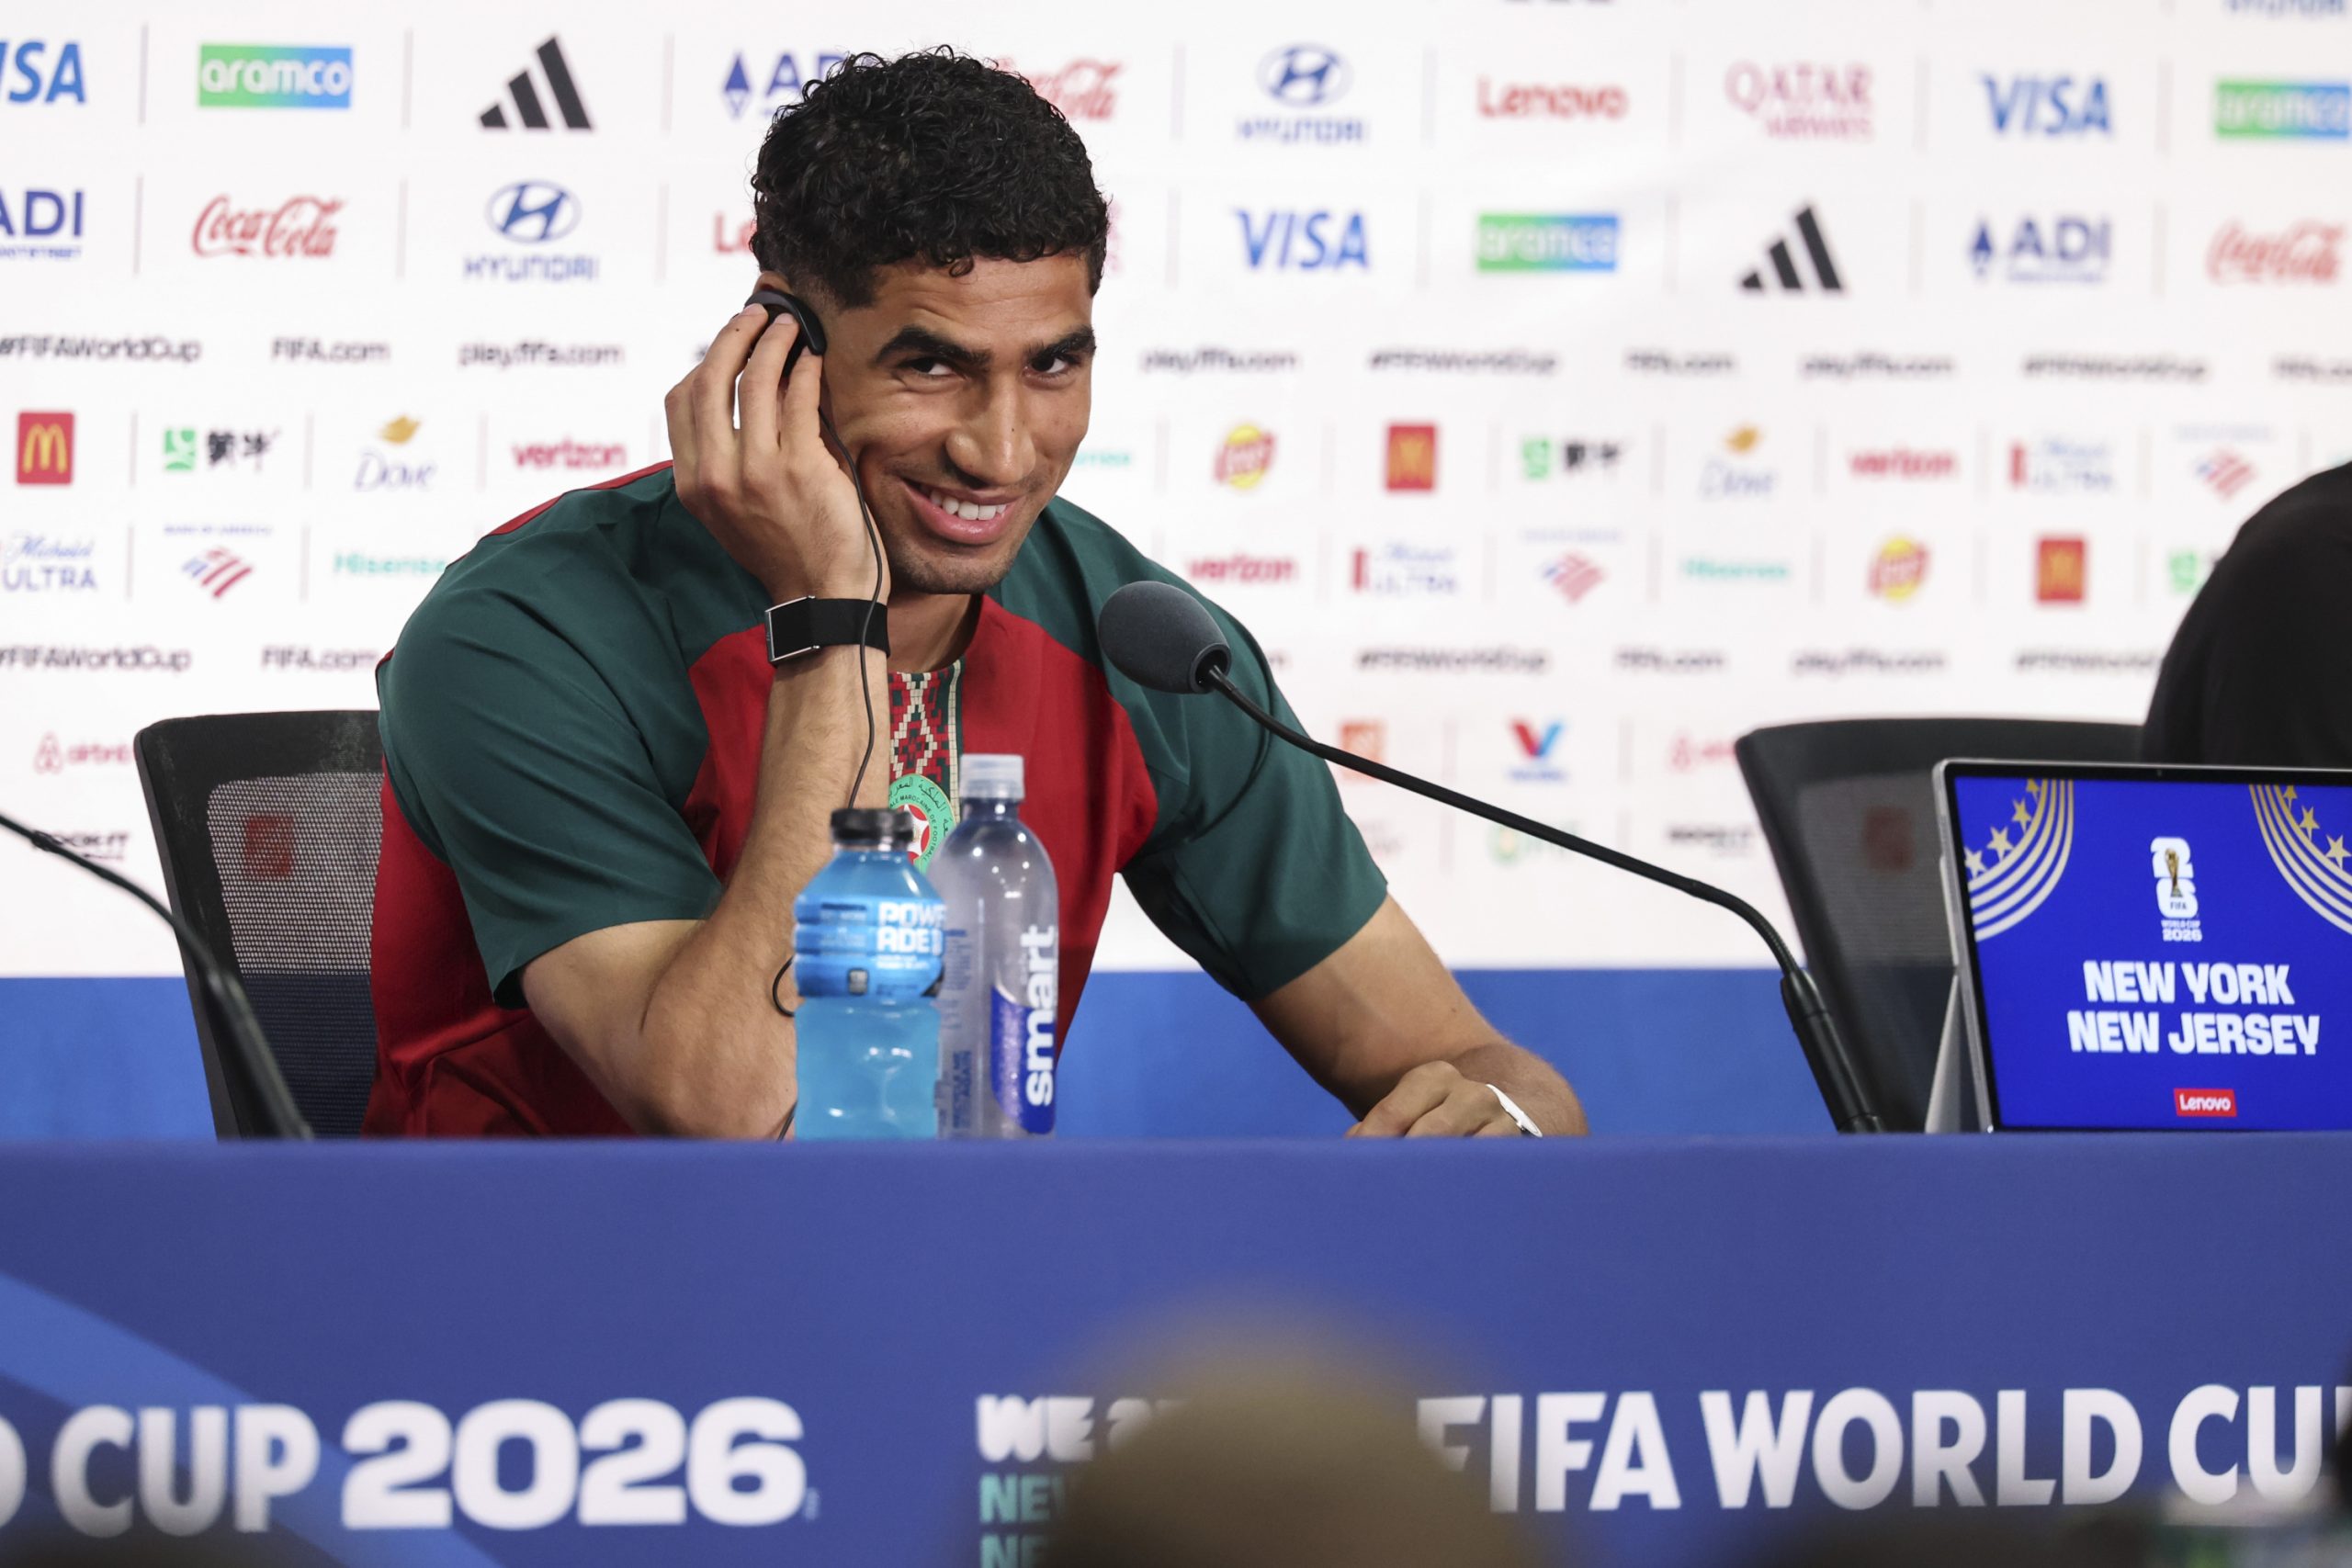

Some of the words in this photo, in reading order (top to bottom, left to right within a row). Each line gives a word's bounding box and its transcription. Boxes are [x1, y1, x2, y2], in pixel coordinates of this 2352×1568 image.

[0, 42, 85, 103] SA
[201, 60, 351, 96] aramco
[1476, 73, 1628, 119] Lenovo
[1983, 75, 2110, 134] VISA
[1235, 211, 1369, 268] VISA
[2010, 219, 2111, 262] ADI
[273, 338, 390, 361] FIFA.com
[355, 450, 436, 491] Dove
[511, 438, 625, 467] verizon
[1, 567, 96, 592] ULTRA
[900, 795, 931, 813] MAROCAINE
[2170, 901, 2188, 910] FIFA
[2162, 929, 2203, 942] 2026
[2083, 960, 2177, 1003] NEW
[2181, 962, 2295, 1005] YORK
[1020, 924, 1057, 1107] smart
[2067, 1010, 2160, 1053] NEW
[2167, 1012, 2321, 1055] JERSEY
[2178, 1093, 2232, 1111] Lenovo
[976, 1393, 1095, 1463] WE
[1417, 1391, 1682, 1514] FIFA
[1699, 1385, 2143, 1512] WORLD
[2168, 1383, 2352, 1506] CU
[51, 1404, 321, 1539] CUP
[341, 1395, 808, 1531] 2026
[978, 1473, 1066, 1525] NE
